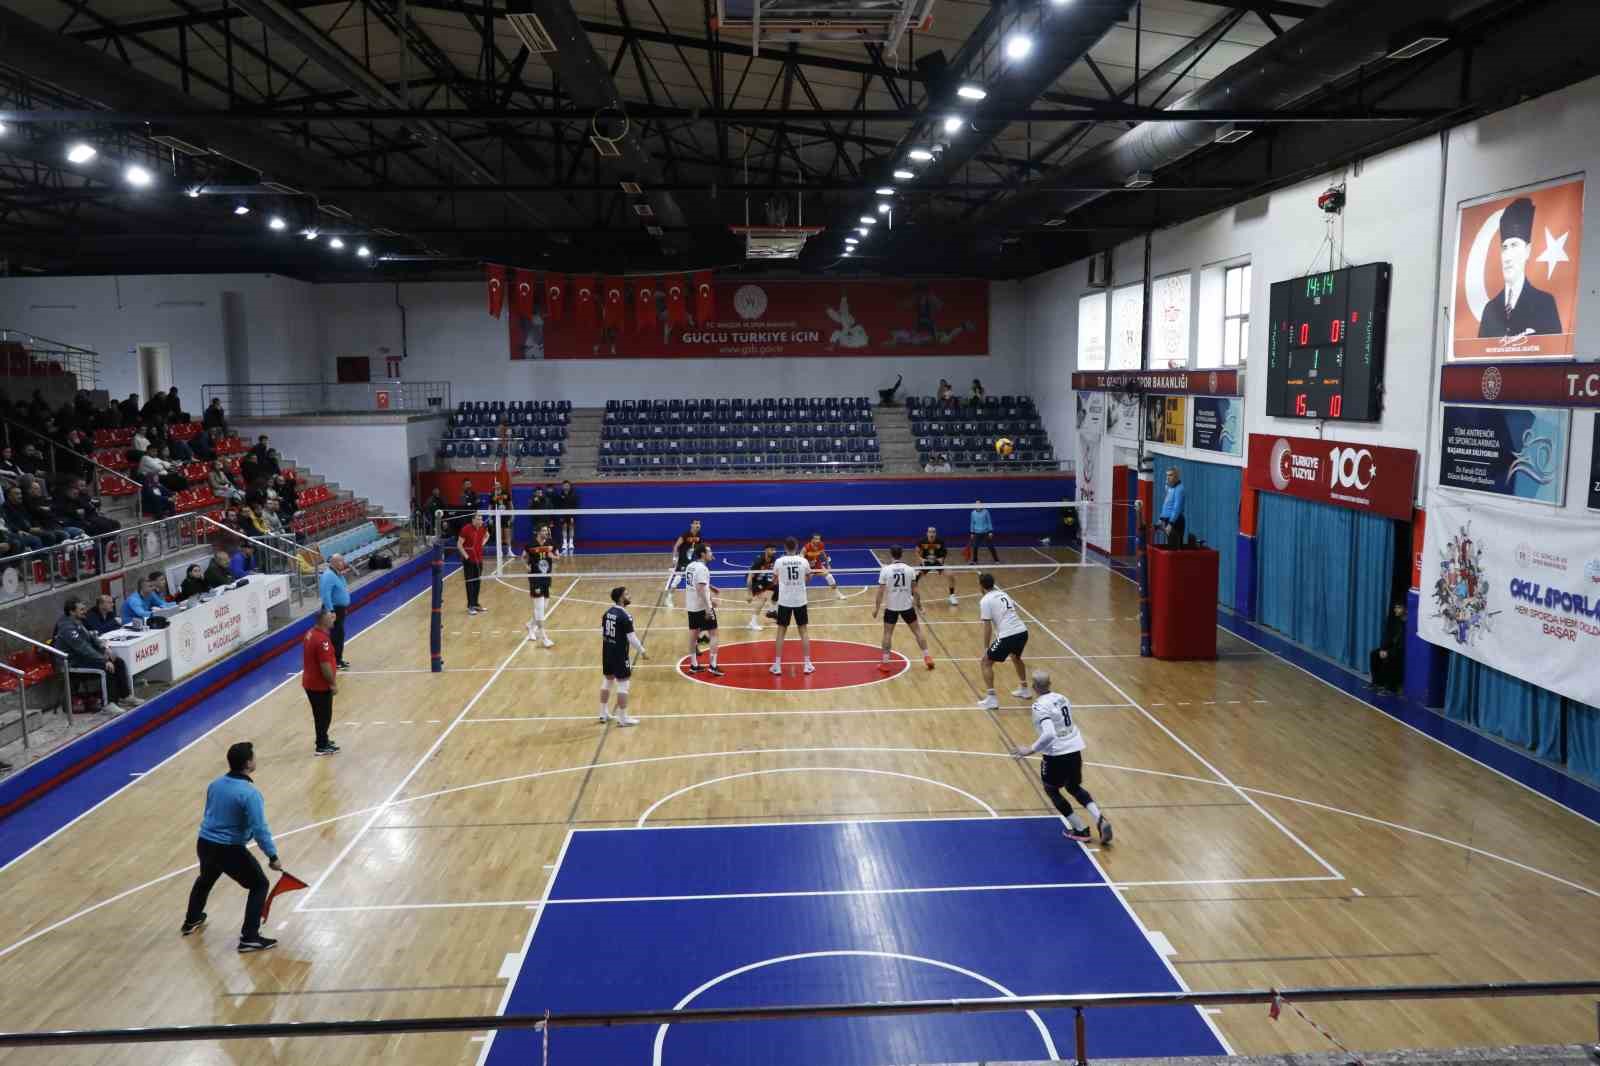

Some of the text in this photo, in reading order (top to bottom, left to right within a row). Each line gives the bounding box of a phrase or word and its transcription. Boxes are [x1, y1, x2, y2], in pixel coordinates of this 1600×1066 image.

[1307, 273, 1334, 297] 14:14
[1300, 323, 1309, 345] 0
[1331, 319, 1341, 342] 0
[1152, 373, 1188, 389] BAKANLIĞI
[1296, 394, 1342, 417] 15 10
[787, 566, 799, 581] 15
[893, 573, 906, 588] 21
[605, 619, 616, 638] 95
[135, 642, 159, 664] HAKEM
[1061, 706, 1072, 727] 8
